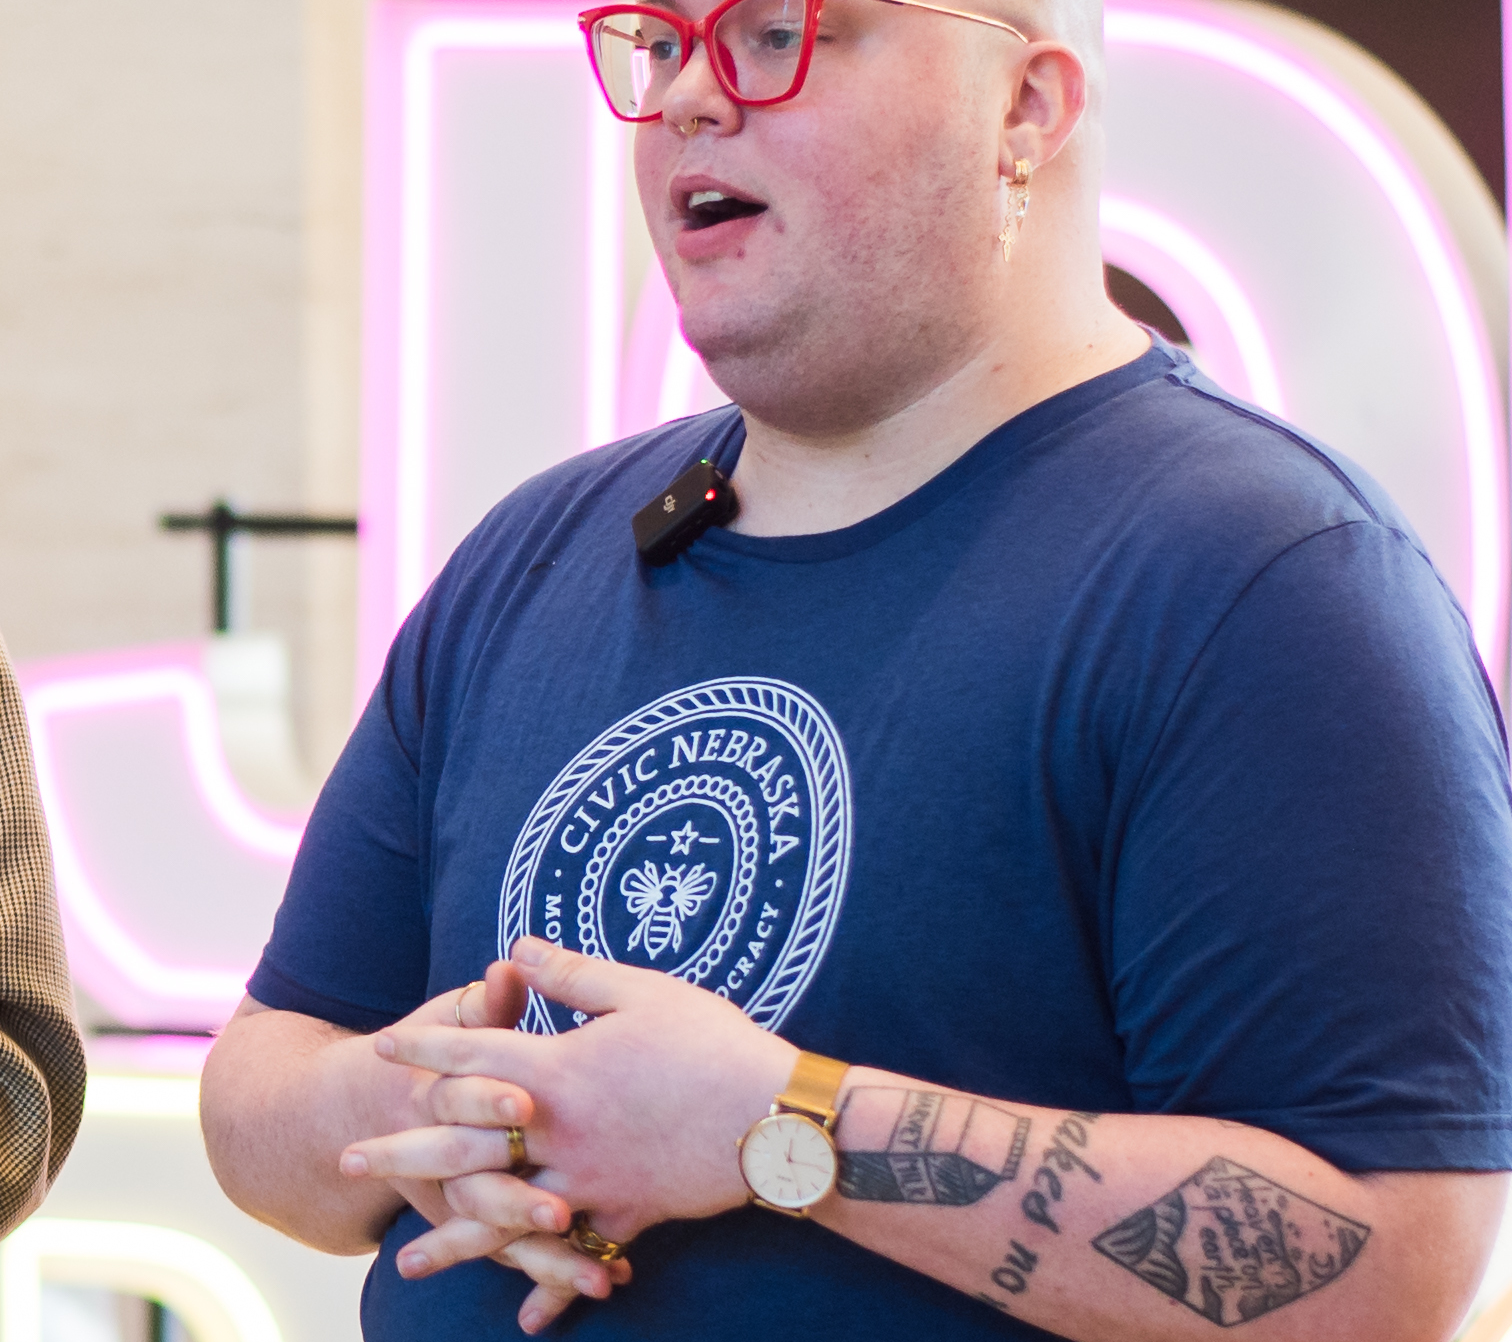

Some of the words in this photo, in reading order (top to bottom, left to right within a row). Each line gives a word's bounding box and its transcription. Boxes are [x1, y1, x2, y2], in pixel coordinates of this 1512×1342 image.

[561, 748, 657, 853] CIVIC
[669, 728, 799, 864] NEBRASKA
[715, 902, 779, 1000] OCRACY
[991, 1239, 1039, 1295] no
